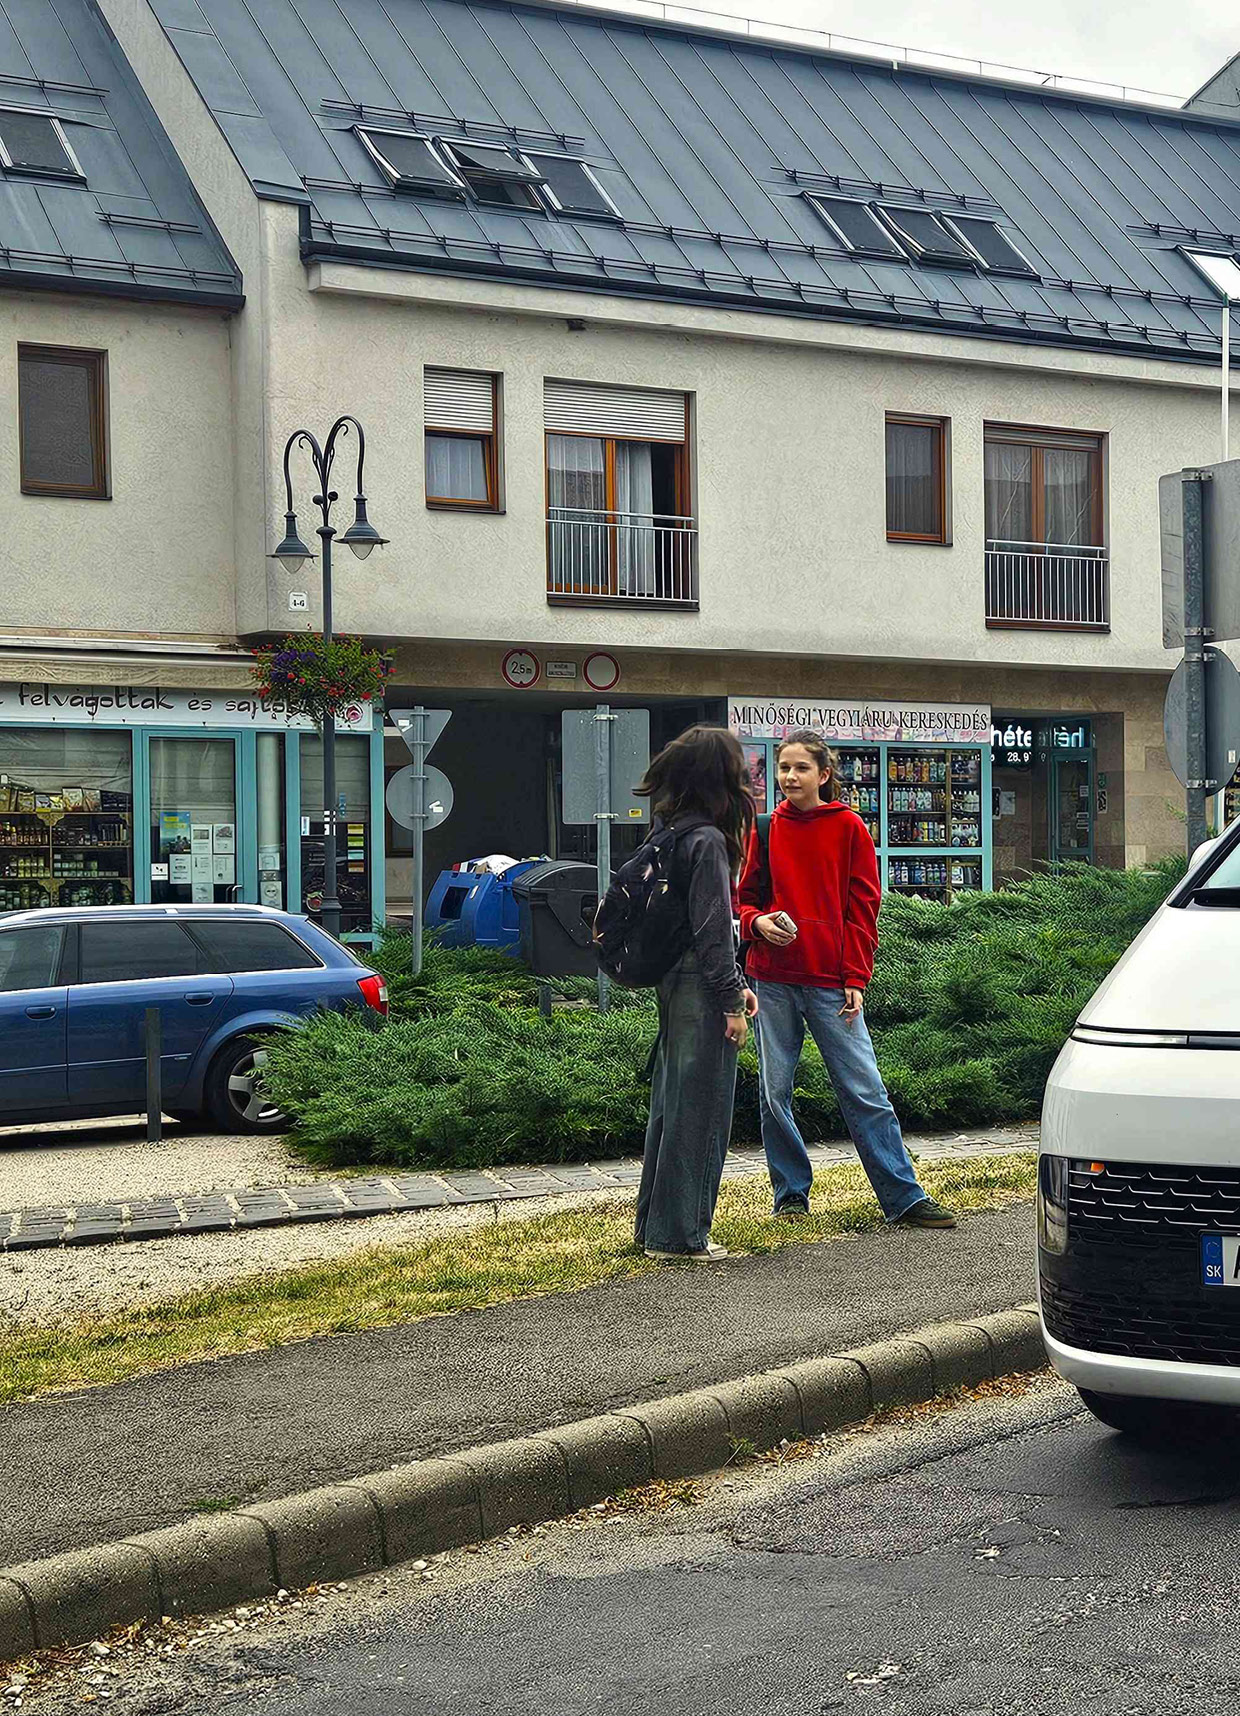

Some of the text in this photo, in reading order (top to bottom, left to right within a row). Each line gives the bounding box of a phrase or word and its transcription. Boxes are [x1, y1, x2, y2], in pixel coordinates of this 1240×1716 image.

[19, 683, 174, 716] felvágottak
[188, 691, 213, 711] és
[225, 700, 290, 720] sajto
[733, 702, 988, 730] MINŐSÉGI VEGYIÁRU KERESKEDÉS
[1206, 1264, 1222, 1278] SK
